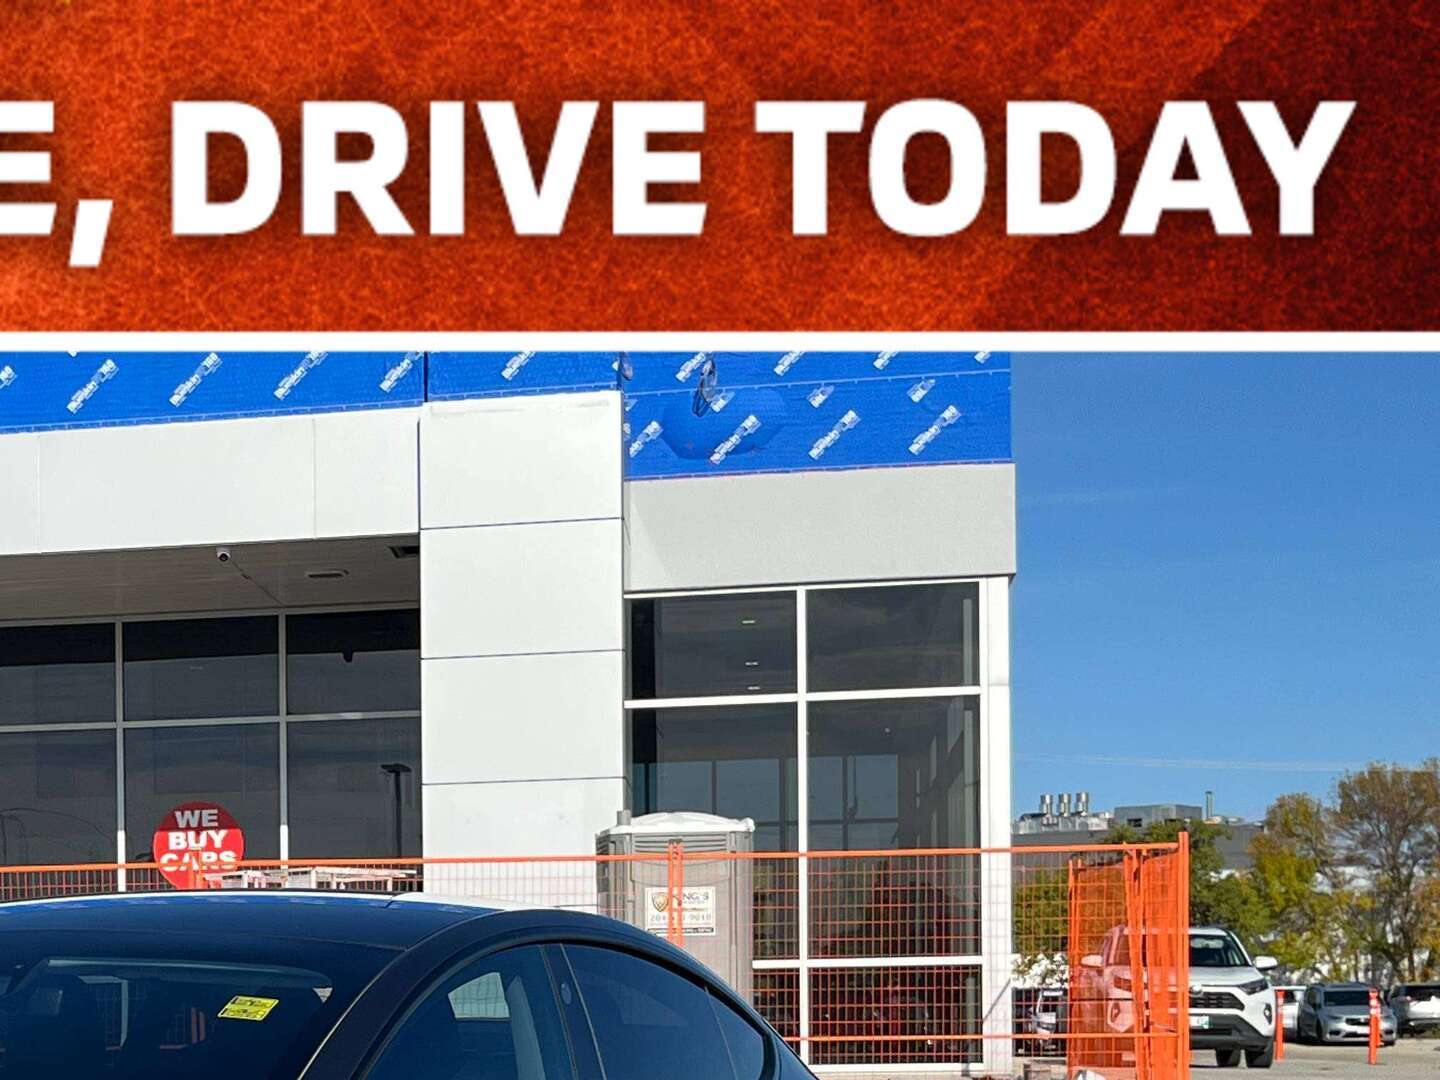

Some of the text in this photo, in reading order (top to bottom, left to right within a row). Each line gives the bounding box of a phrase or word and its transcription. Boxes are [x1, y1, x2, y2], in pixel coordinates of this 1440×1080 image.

[175, 809, 218, 828] WE
[168, 830, 228, 850] BUY
[160, 851, 237, 871] CARS
